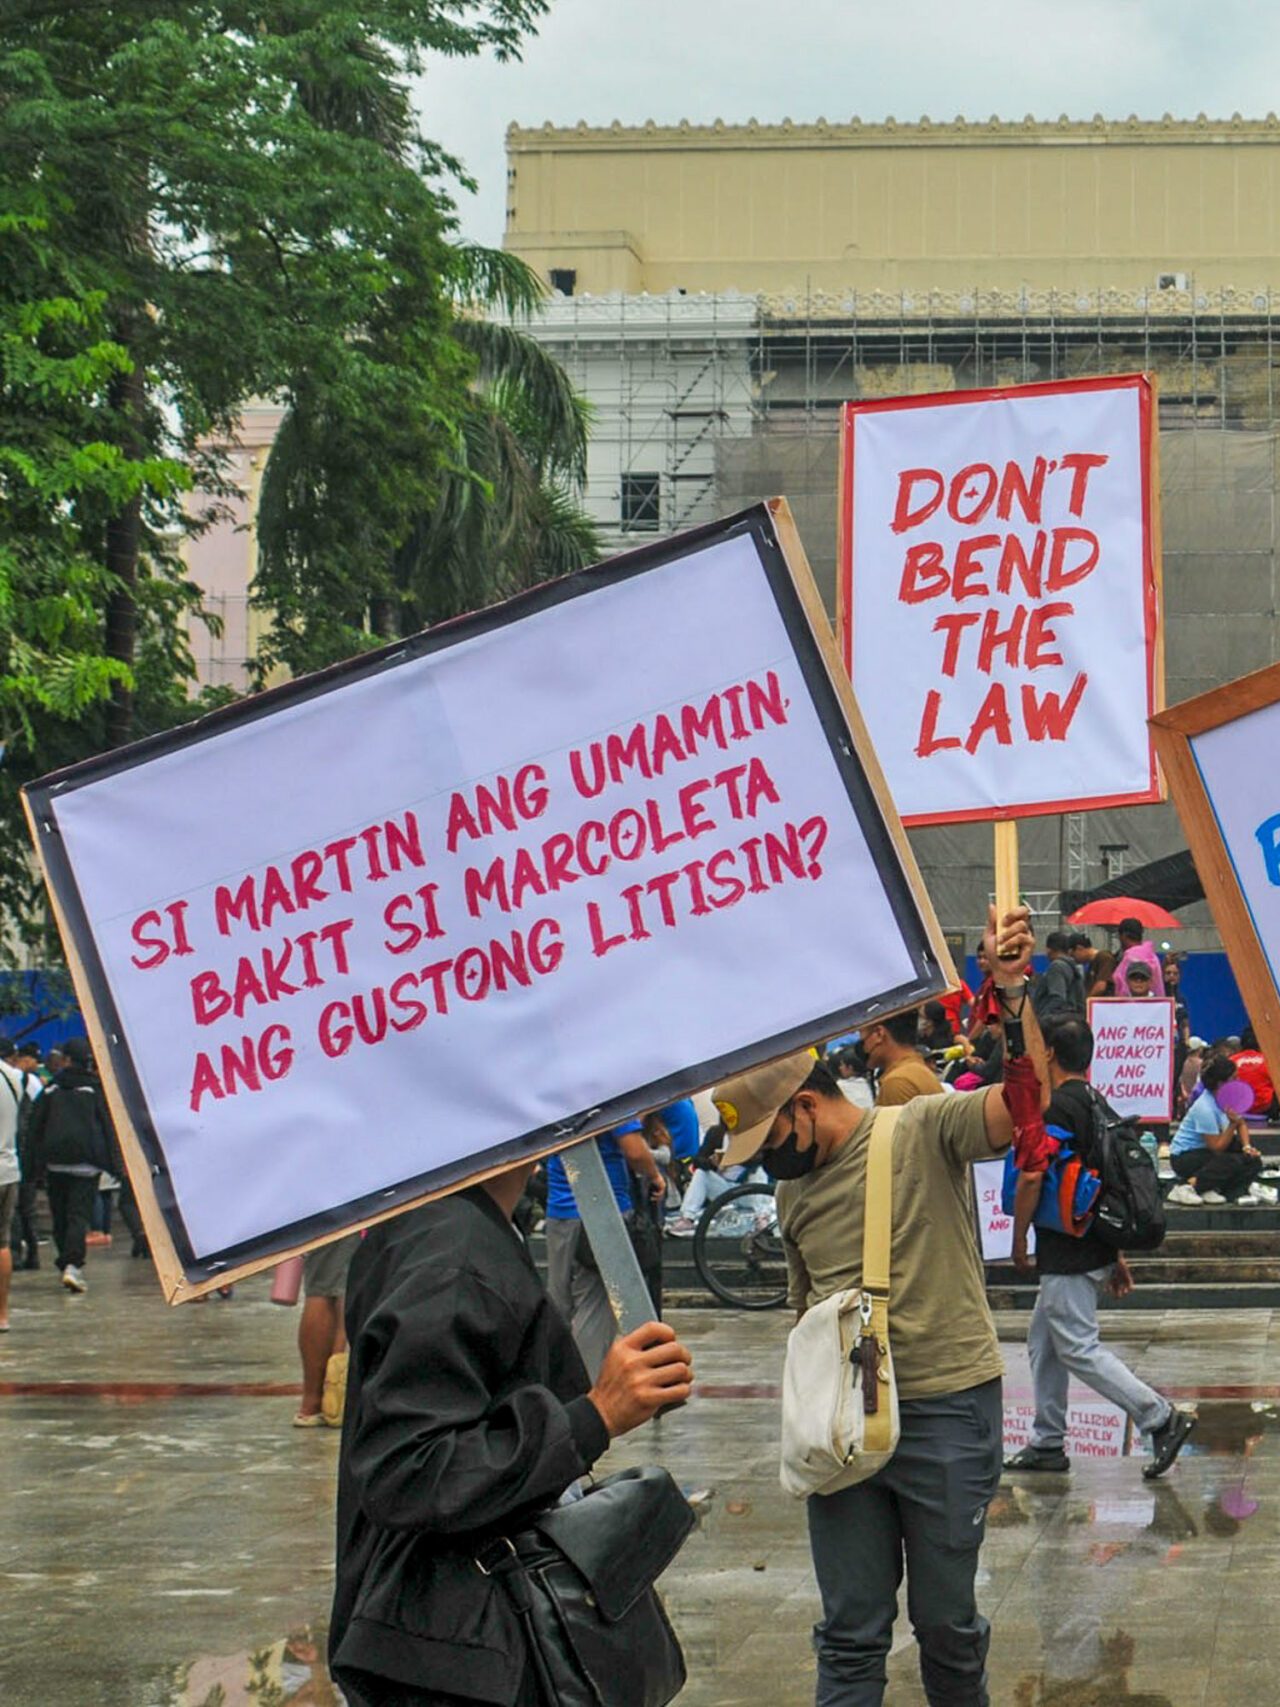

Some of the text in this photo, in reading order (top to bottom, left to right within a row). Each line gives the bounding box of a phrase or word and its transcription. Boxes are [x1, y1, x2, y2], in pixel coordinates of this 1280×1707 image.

[889, 453, 1109, 535] DON'T
[898, 527, 1100, 605] BEND
[931, 602, 1074, 678] THE
[913, 669, 1087, 757] LAW
[131, 900, 194, 970] SI
[215, 810, 425, 935] MARTIN
[446, 765, 548, 852] ANG
[190, 757, 779, 1026] BAKIT SI MARCOLETA
[189, 815, 827, 1112] ANG GUSTONG LITISIN?
[1095, 1045, 1165, 1060] KURAKOT
[1097, 1026, 1165, 1040] ANG MGA
[1114, 1064, 1146, 1078] ANG
[988, 1219, 1010, 1232] ANG
